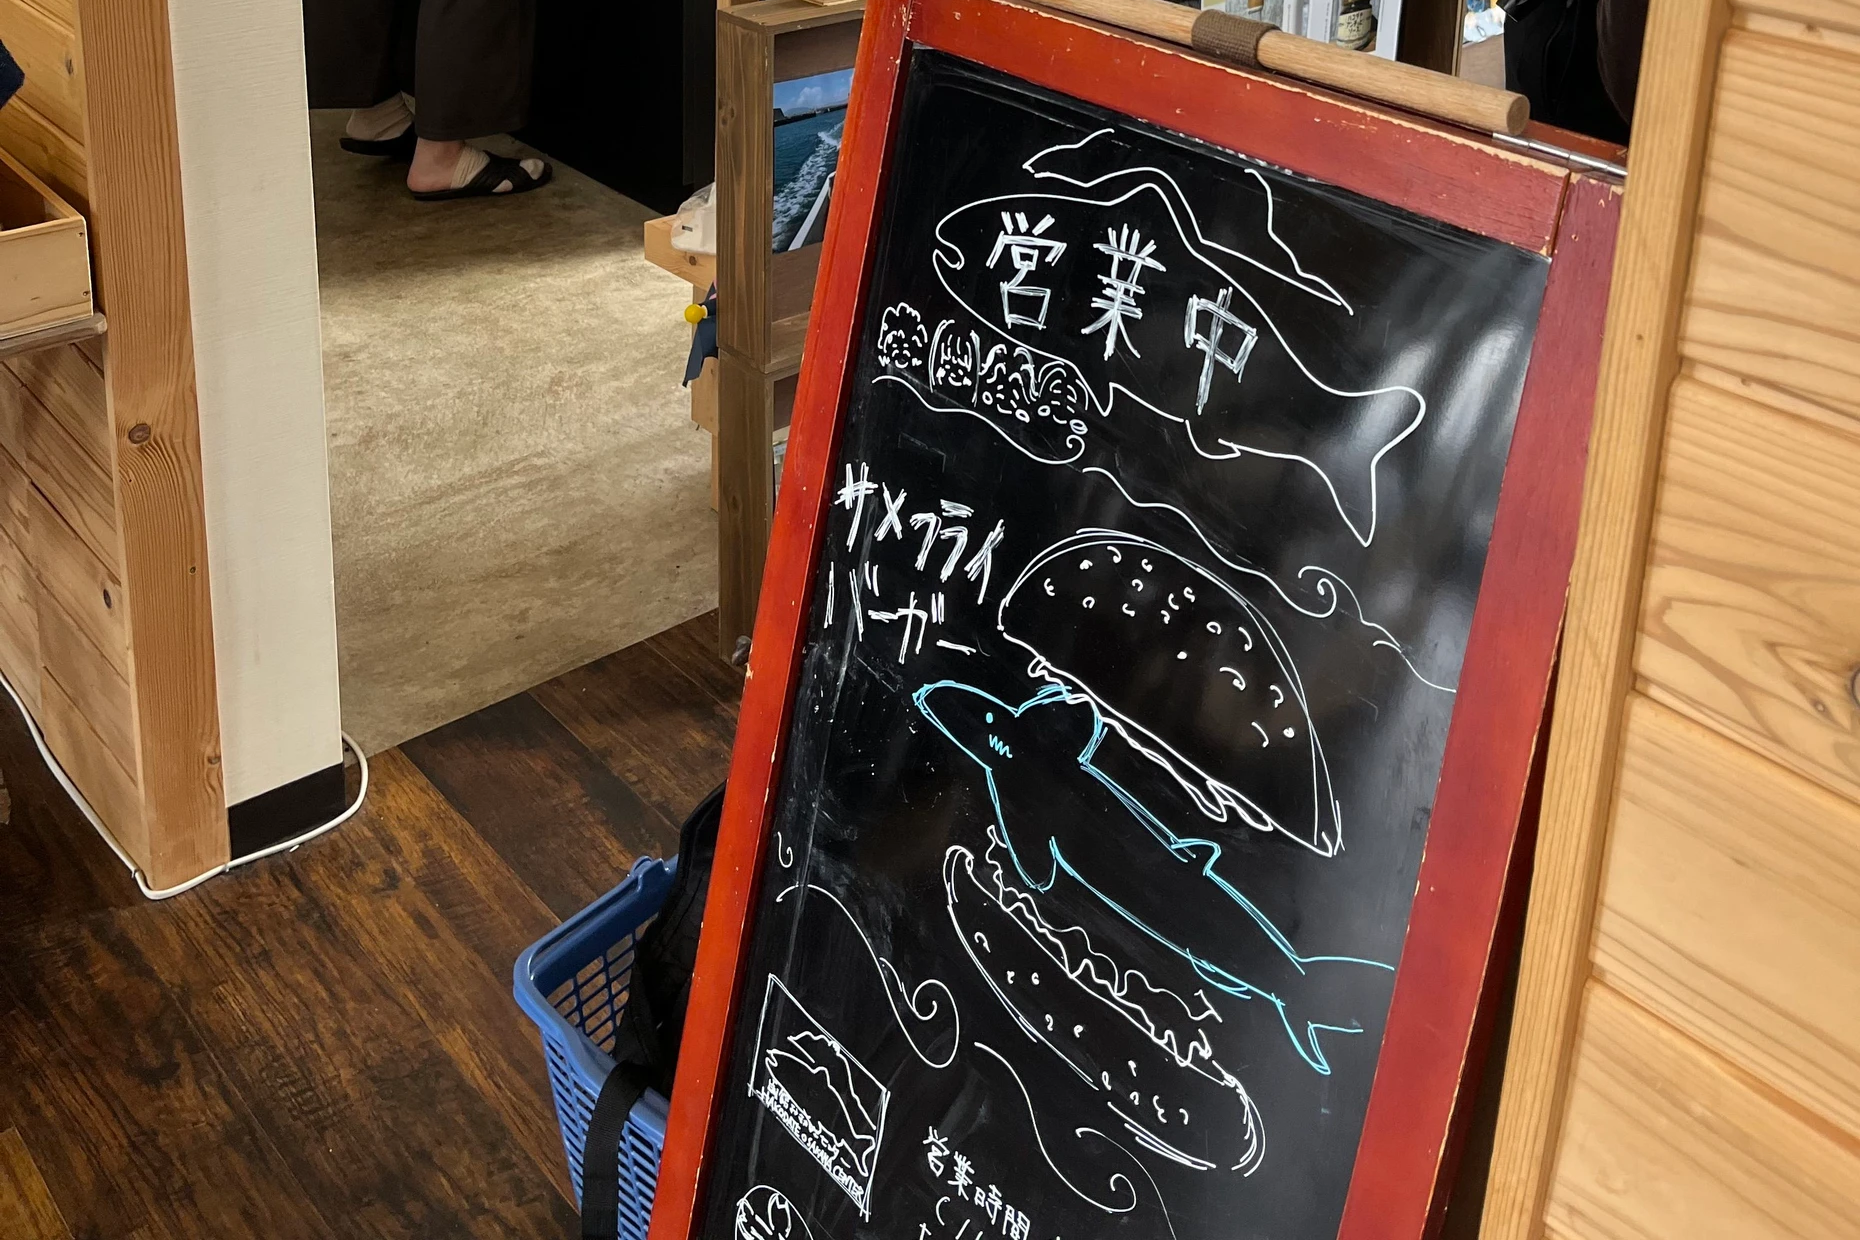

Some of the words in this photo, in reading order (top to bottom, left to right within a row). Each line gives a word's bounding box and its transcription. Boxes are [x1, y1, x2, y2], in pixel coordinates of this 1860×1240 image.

[986, 209, 1258, 415] 営業中
[834, 461, 1005, 605] サメフライ
[823, 561, 977, 665] バーガー
[756, 1085, 803, 1139] HAKODATE
[832, 1165, 865, 1203] CENTER
[922, 1125, 1031, 1240] 営業時間
